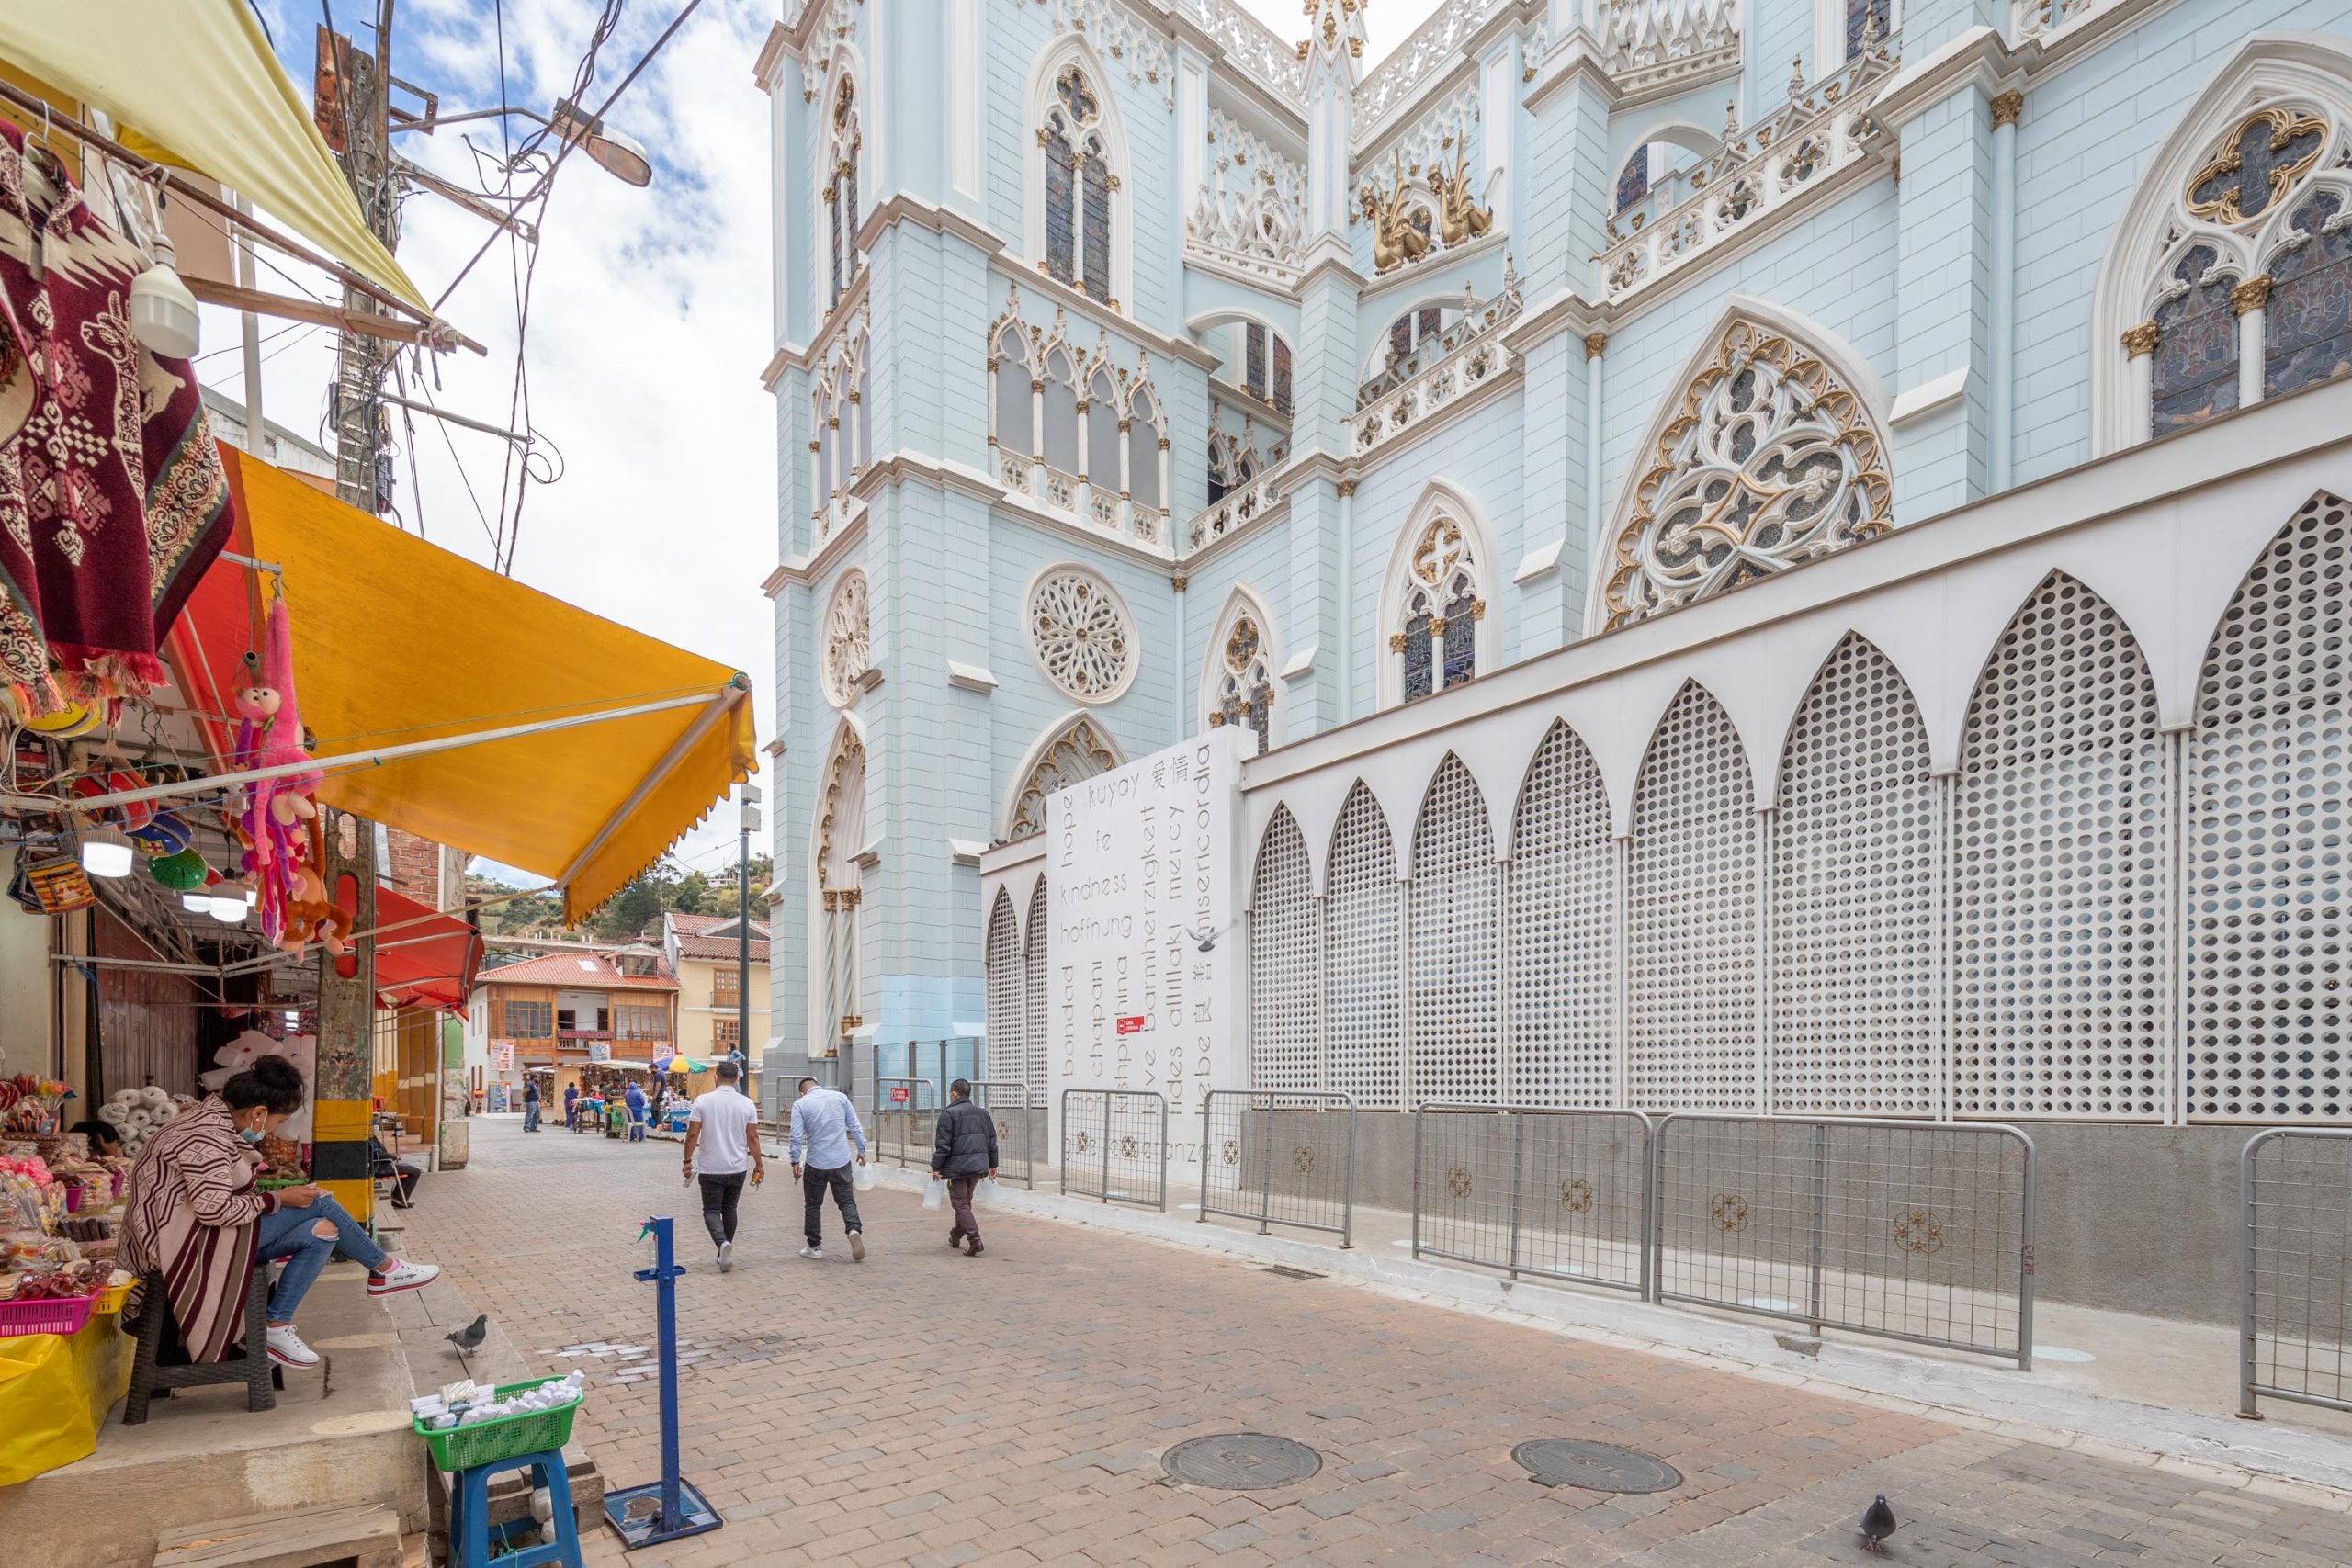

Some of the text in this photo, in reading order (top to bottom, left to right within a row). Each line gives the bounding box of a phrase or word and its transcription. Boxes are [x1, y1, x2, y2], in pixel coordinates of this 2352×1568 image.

[1060, 794, 1077, 868] hope
[1088, 773, 1140, 809] kuyay
[1095, 829, 1111, 853] fe
[1168, 806, 1185, 900] mercy
[1193, 743, 1211, 935] misericordia
[1060, 874, 1128, 907] kindness
[1060, 914, 1133, 948] hoffnung
[1139, 807, 1159, 1032] barmherzigkeit
[1061, 965, 1074, 1077] bondad
[1089, 961, 1106, 1078] chapani
[1114, 956, 1132, 1114] kishpihina
[1166, 1045, 1182, 1115] fides
